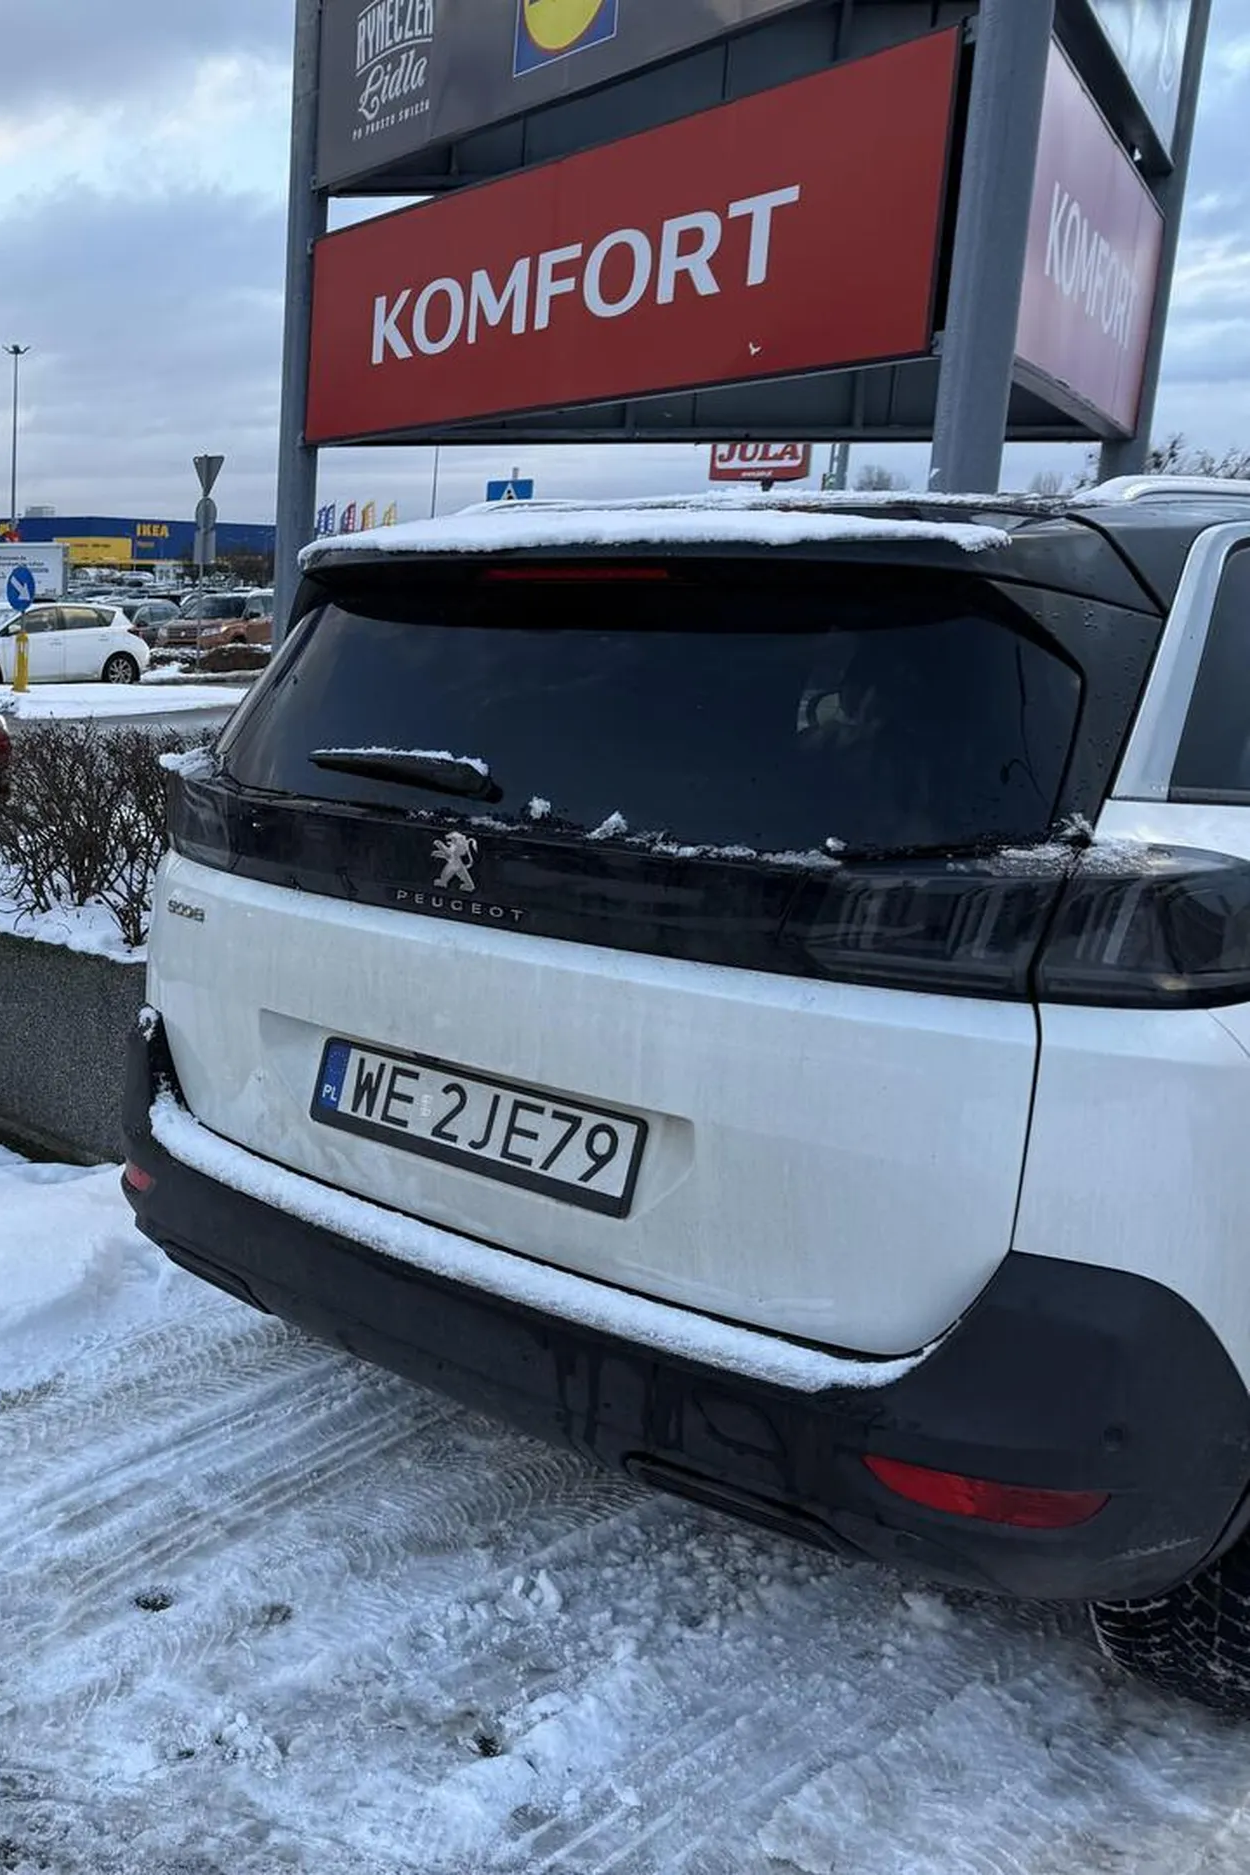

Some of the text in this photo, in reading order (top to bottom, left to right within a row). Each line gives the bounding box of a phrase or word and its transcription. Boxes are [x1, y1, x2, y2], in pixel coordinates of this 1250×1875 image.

[358, 48, 428, 121] Lidla
[371, 184, 801, 365] KOMFORT
[1044, 181, 1139, 350] KOMFORT
[136, 523, 169, 537] IKEA
[396, 889, 524, 922] PEUGEOT
[321, 1084, 338, 1102] PL
[350, 1057, 619, 1183] WE 2JE79
